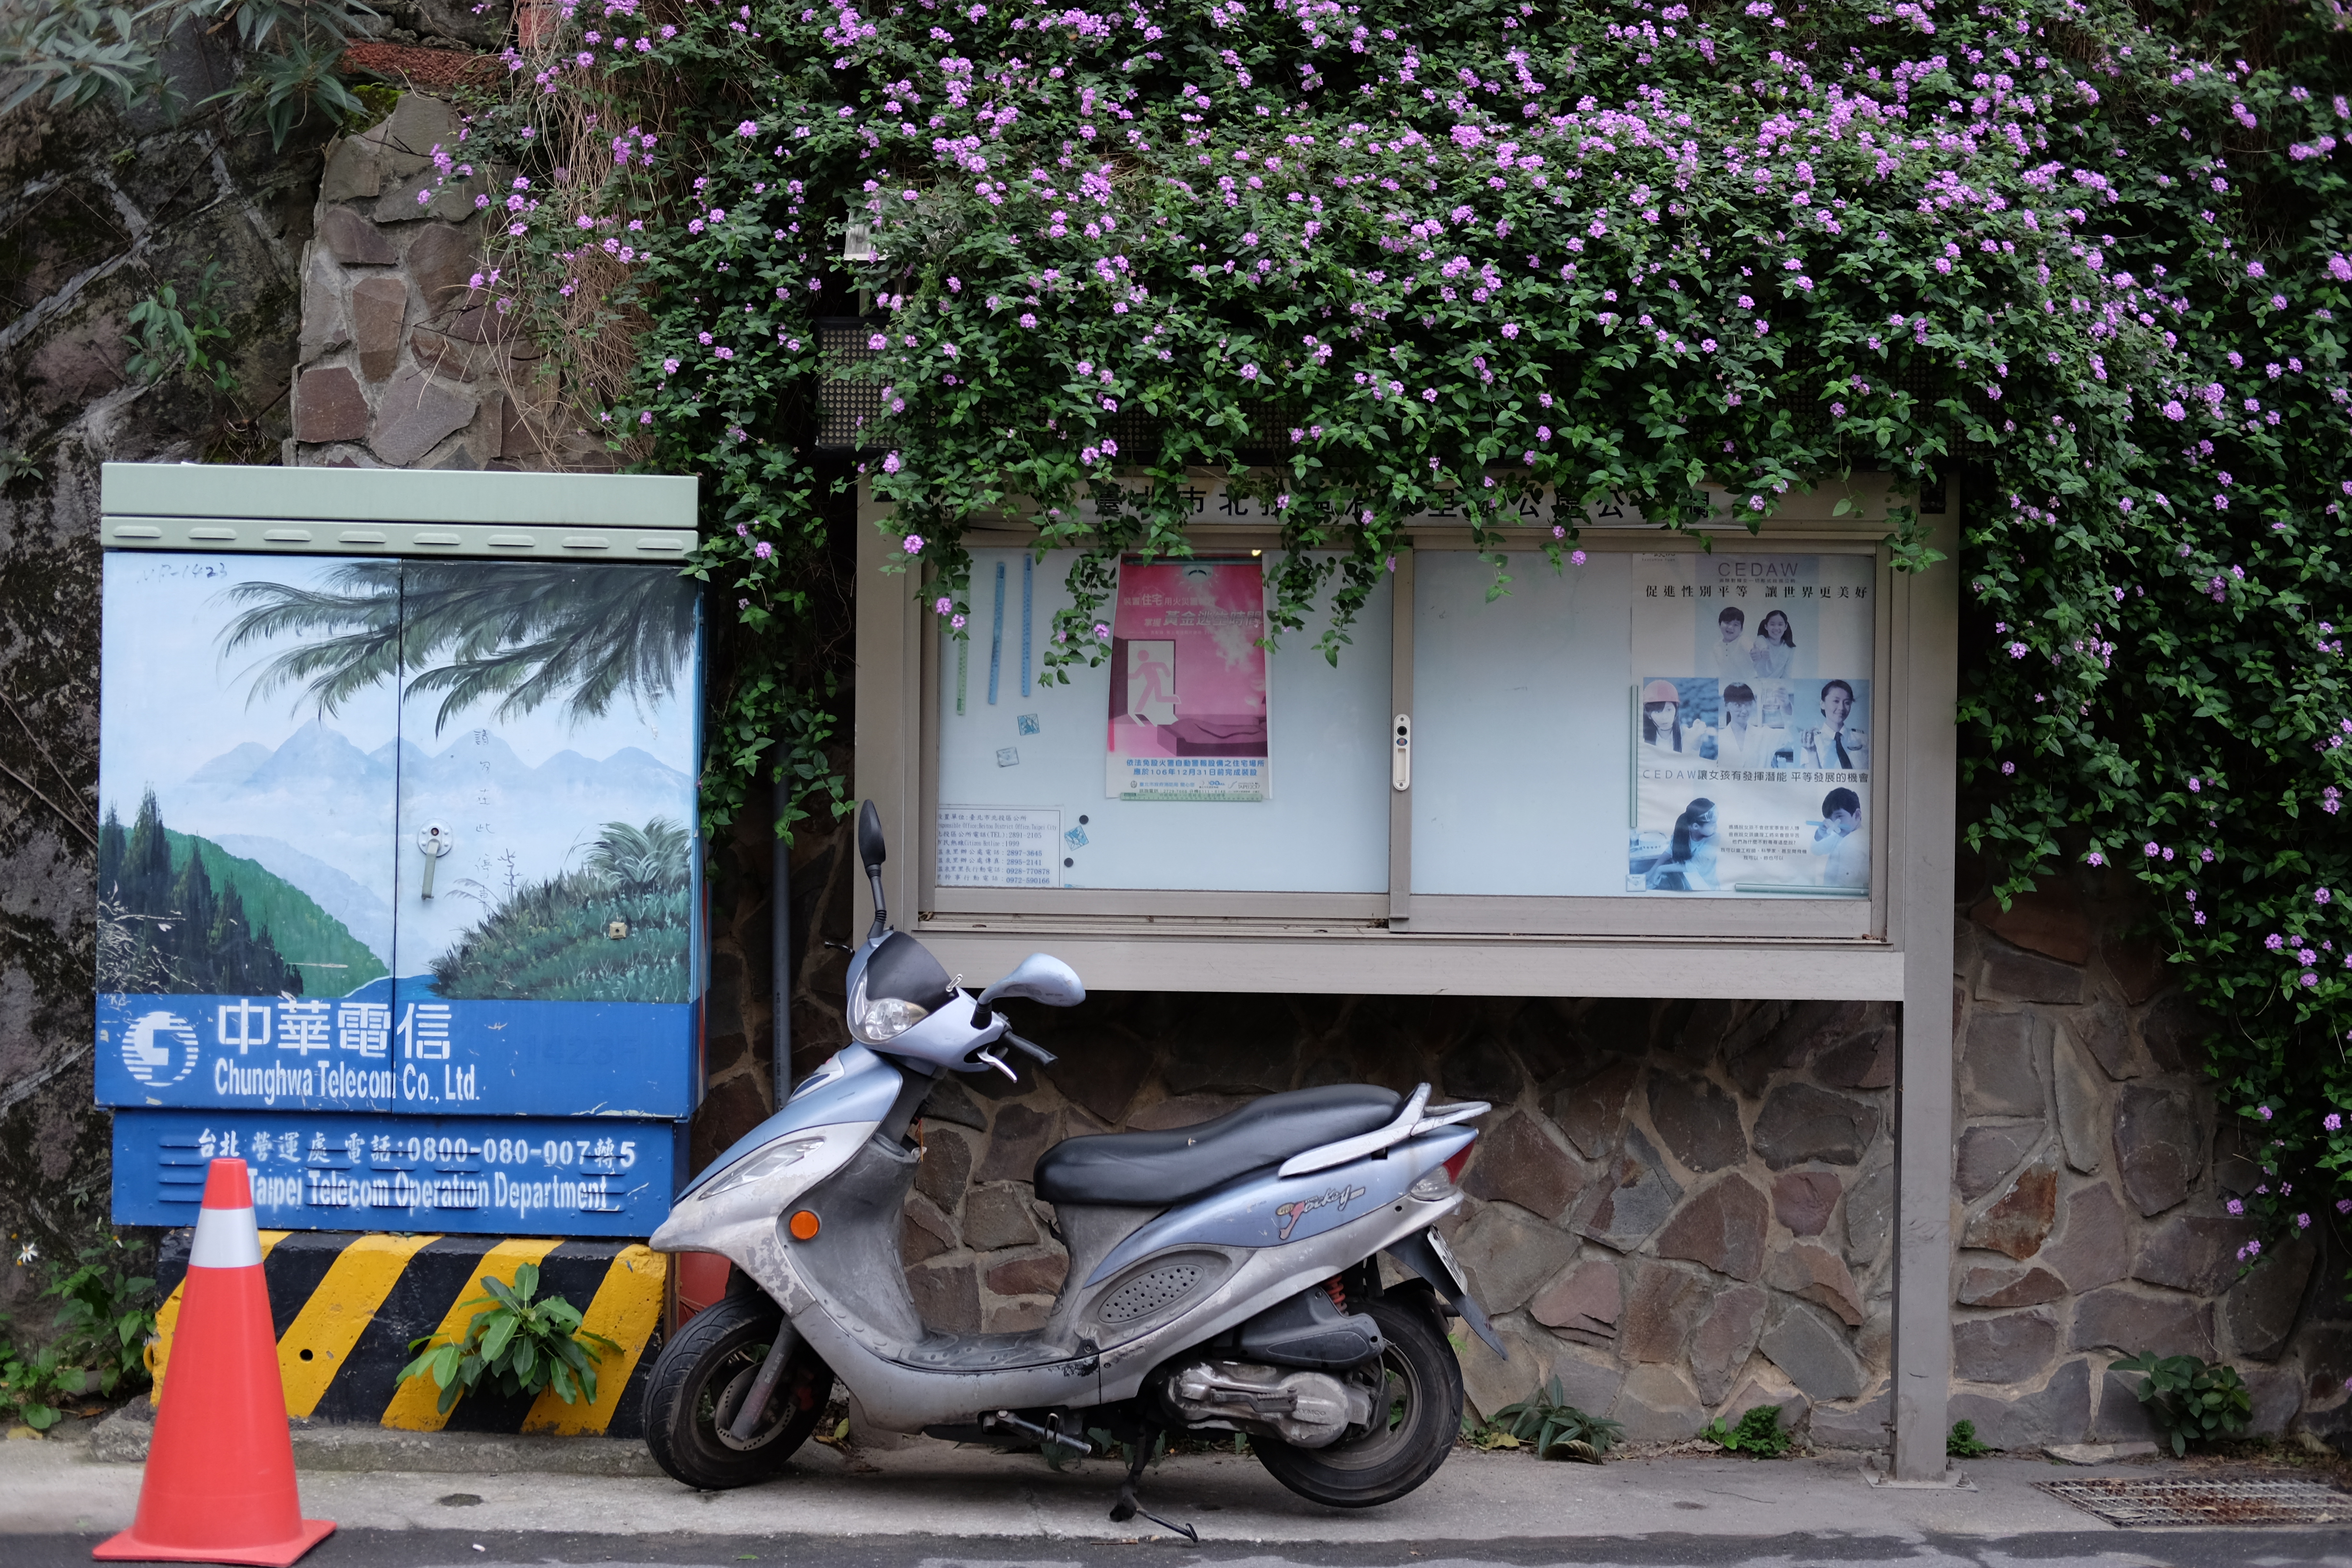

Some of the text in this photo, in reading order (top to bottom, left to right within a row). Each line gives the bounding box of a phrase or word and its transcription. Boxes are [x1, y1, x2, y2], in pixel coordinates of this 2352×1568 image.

[1718, 562, 1799, 576] CEDAW
[1645, 585, 1868, 599] 促進性別平等 讓世界更美好
[1791, 772, 1869, 784] 平等發展的機會
[219, 999, 452, 1059] 中華電信
[215, 1058, 313, 1105] Chunghwa
[317, 1060, 396, 1099] Telecom
[445, 1064, 480, 1101] Ltd.
[247, 1168, 607, 1219] Taipei Telecom Operation Department
